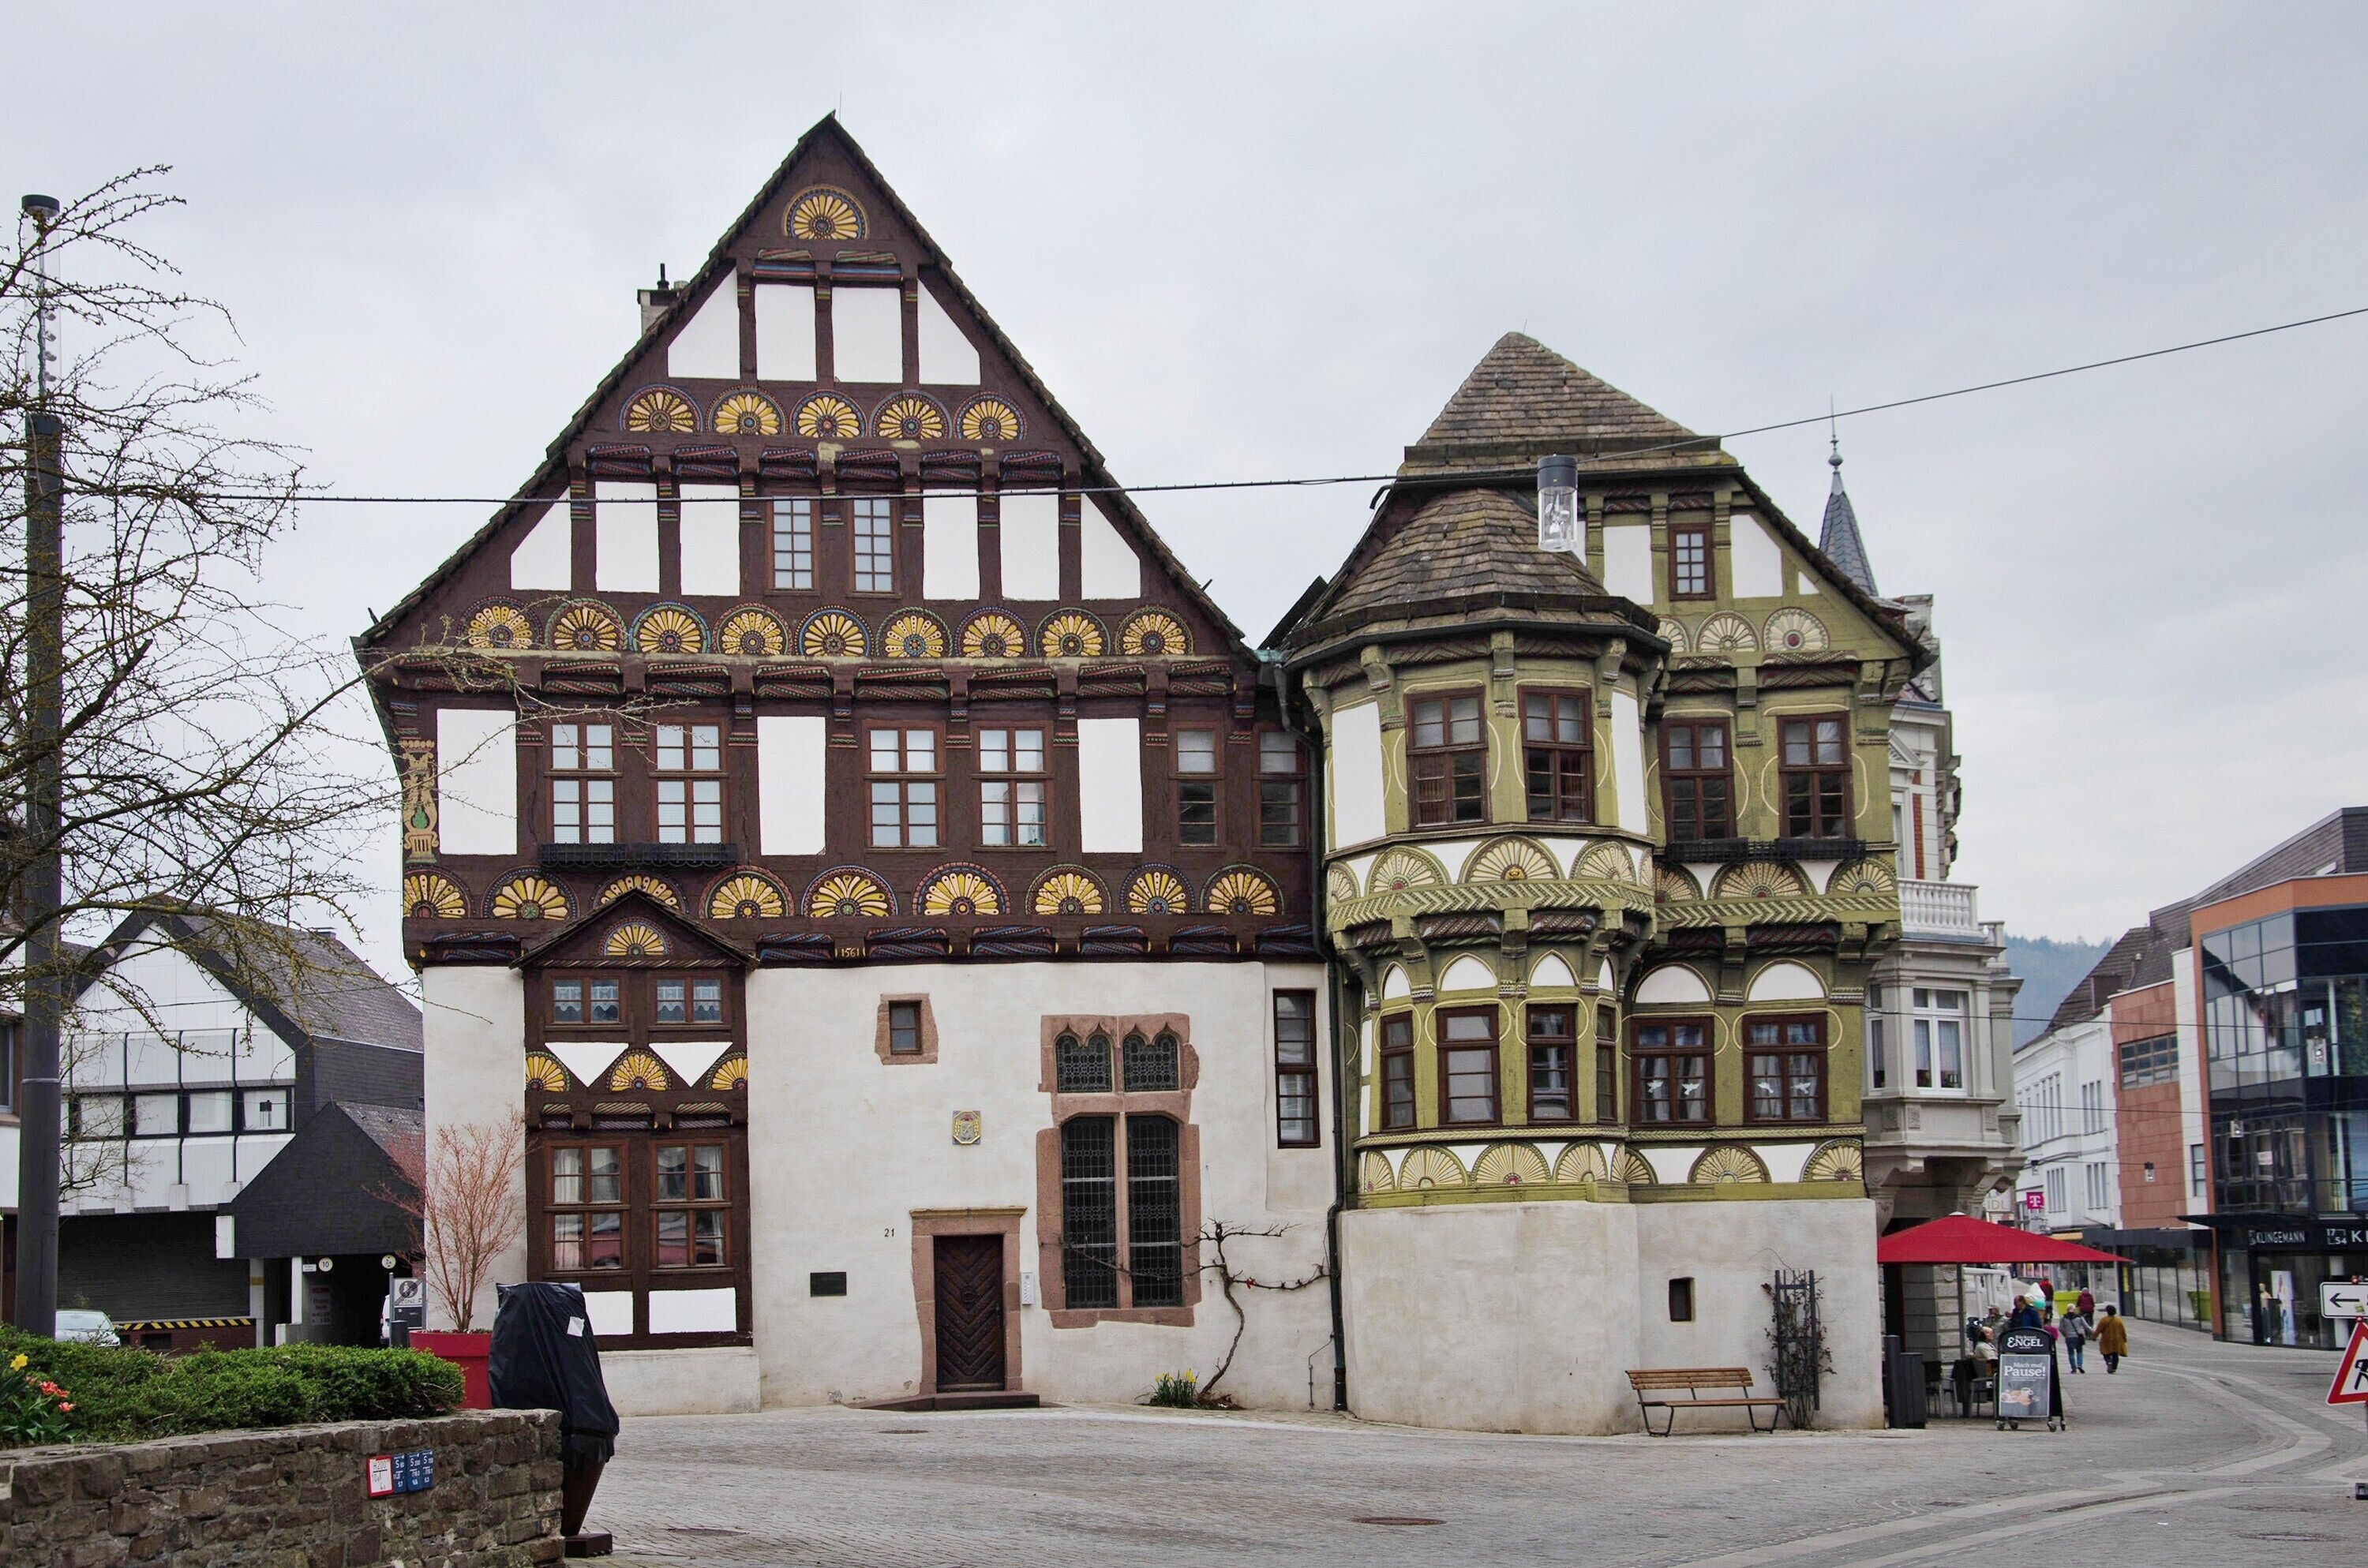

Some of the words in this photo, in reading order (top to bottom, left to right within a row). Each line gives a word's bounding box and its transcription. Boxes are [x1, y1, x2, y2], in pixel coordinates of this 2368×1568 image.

[841, 947, 860, 957] 1561
[884, 1228, 894, 1237] 21
[2256, 1231, 2306, 1244] KLINGEMANN
[2006, 1337, 2044, 1348] ENGEL
[2004, 1366, 2046, 1377] Pause!
